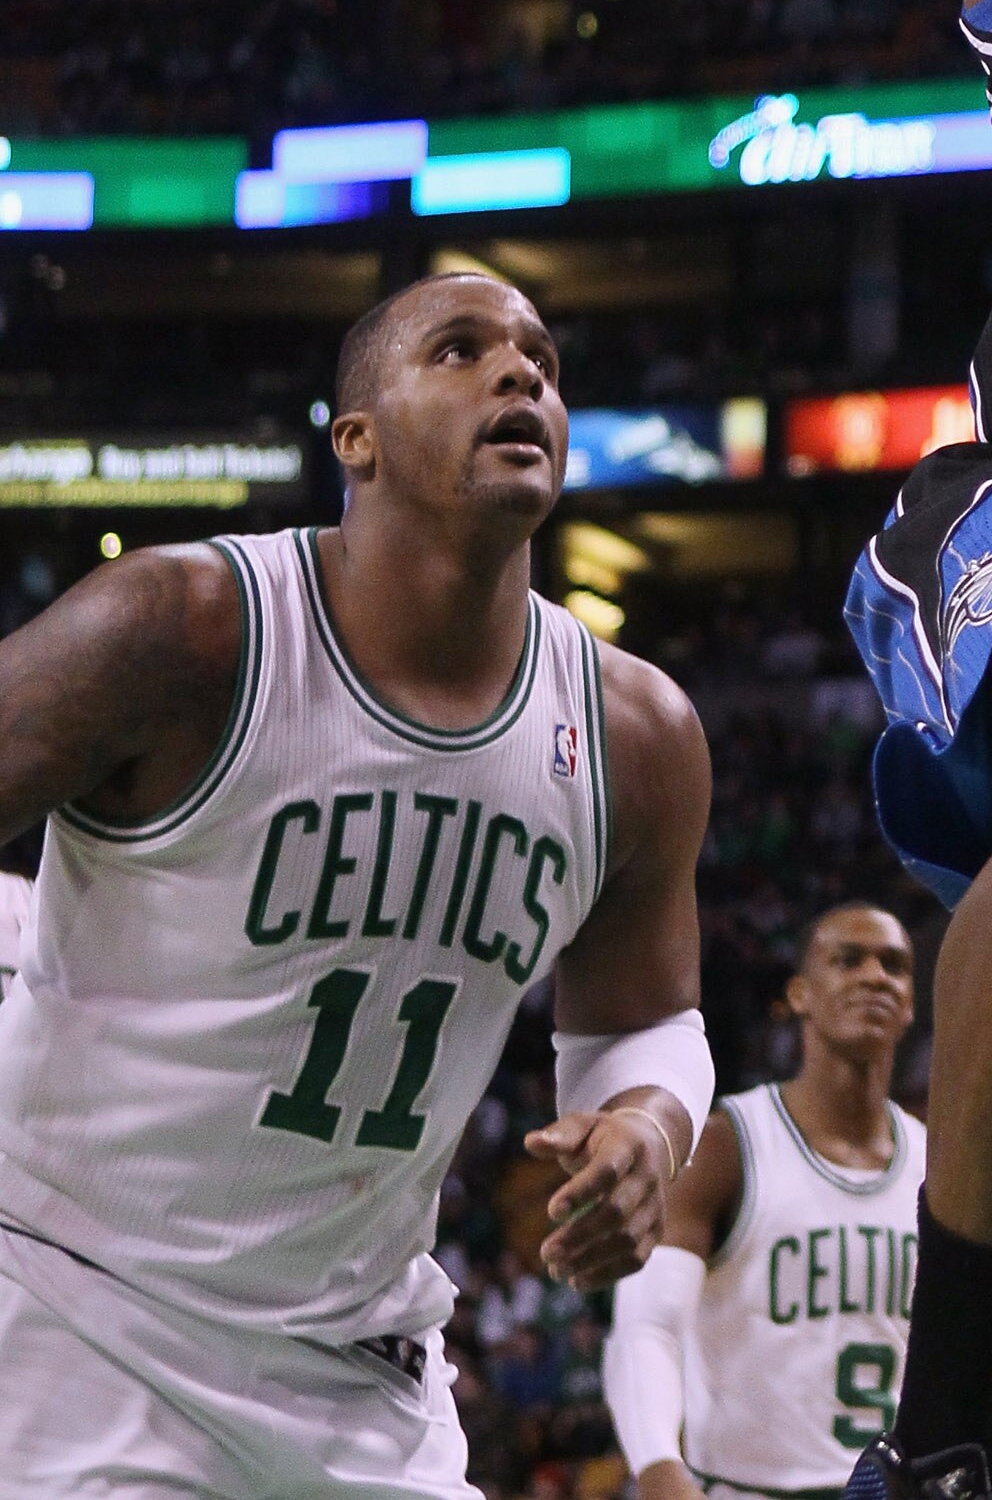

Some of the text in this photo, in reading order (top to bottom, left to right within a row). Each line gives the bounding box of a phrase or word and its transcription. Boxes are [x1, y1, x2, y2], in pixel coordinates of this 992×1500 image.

[243, 789, 568, 986] CELTICS
[257, 966, 460, 1152] 11
[832, 1342, 898, 1449] 9
